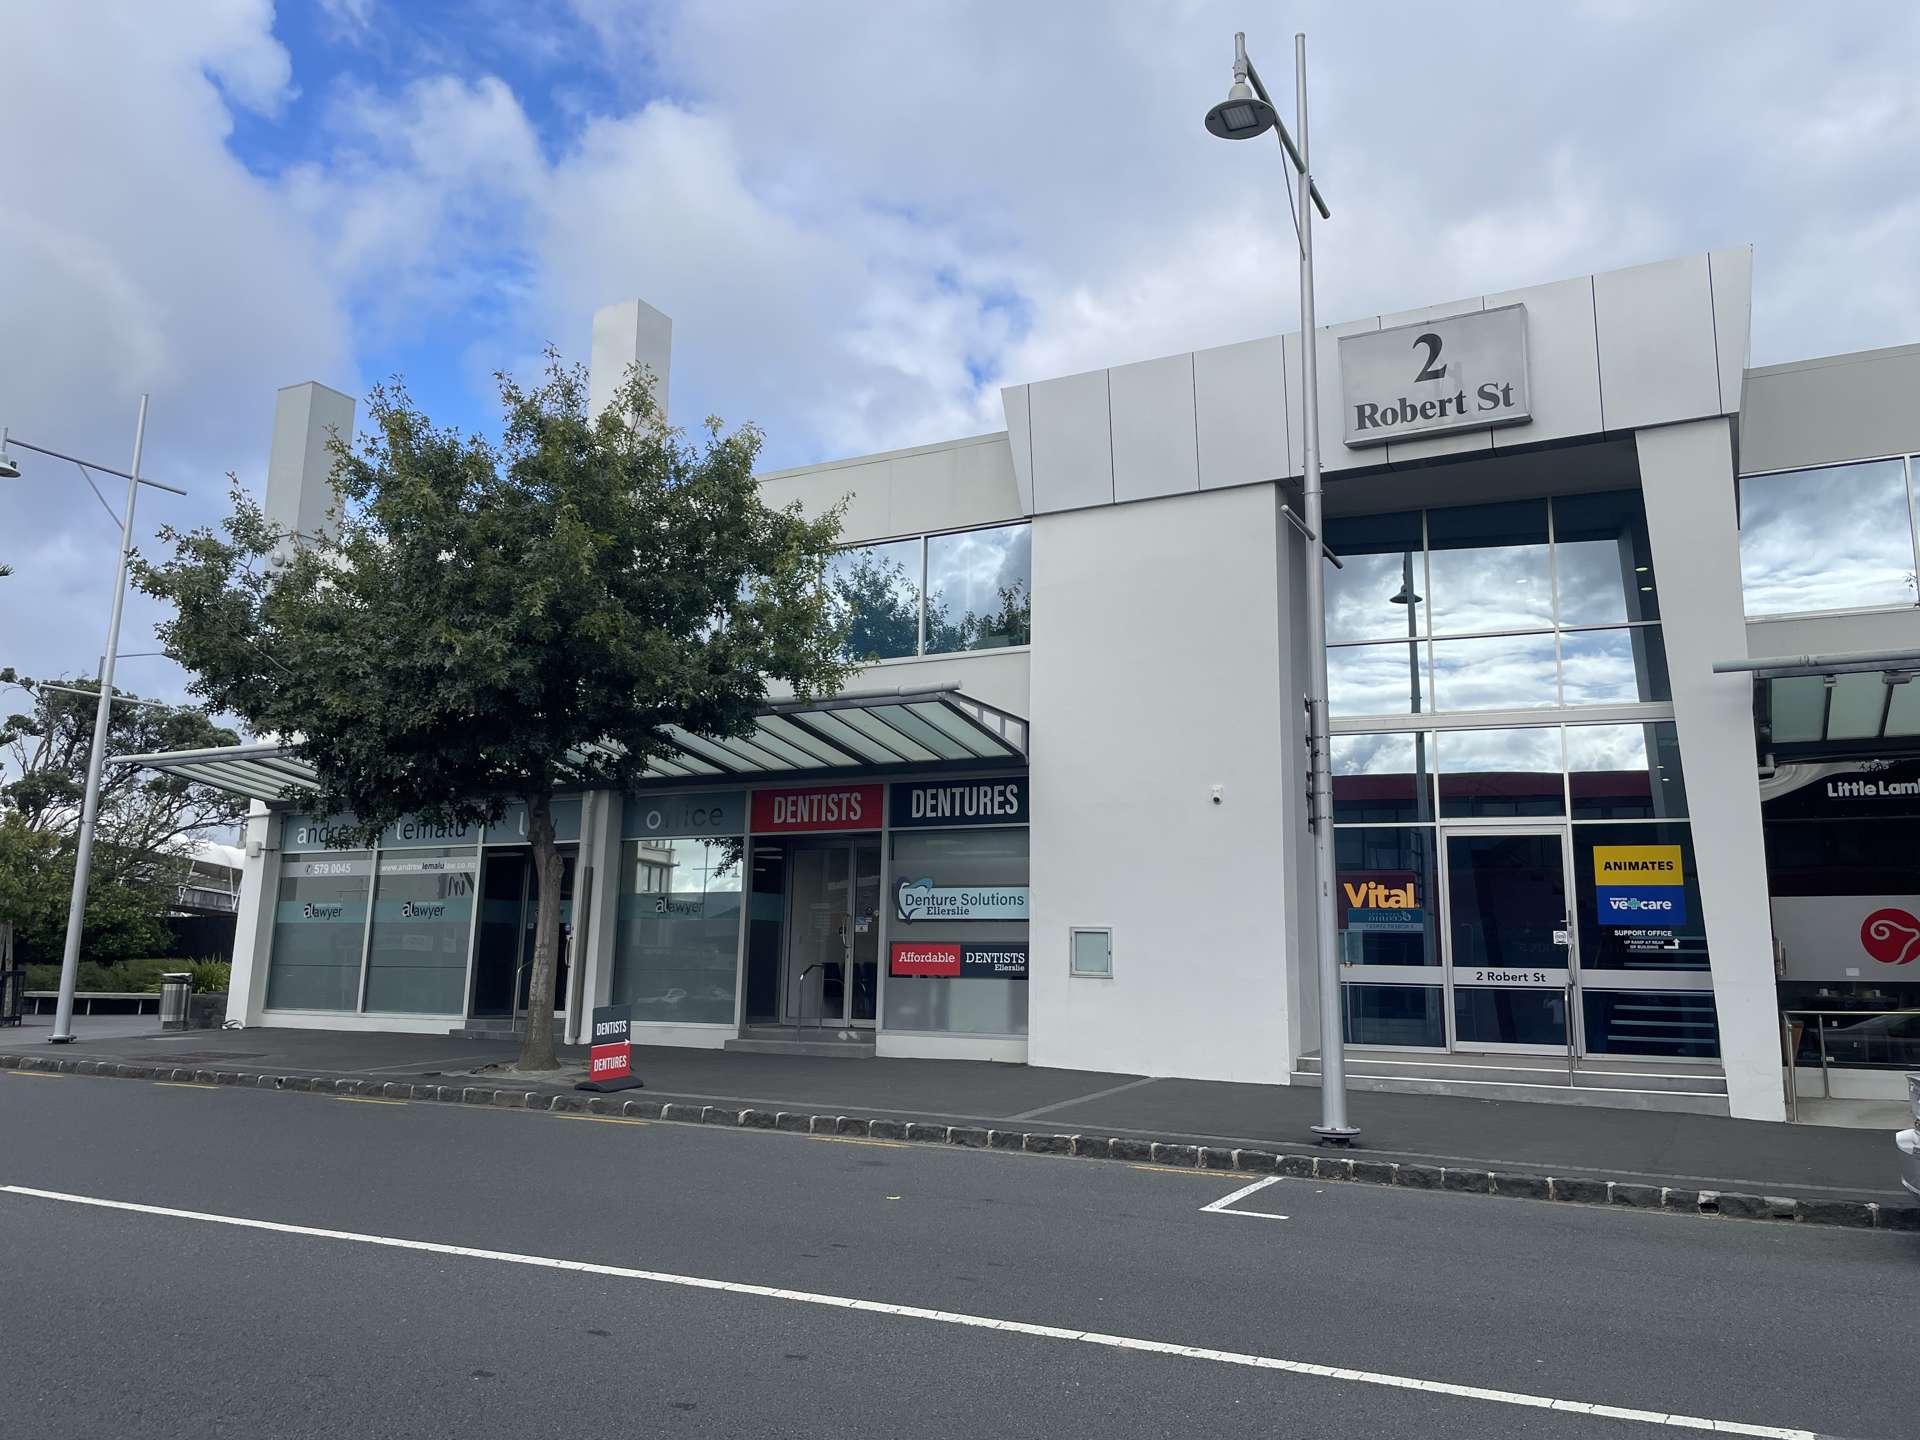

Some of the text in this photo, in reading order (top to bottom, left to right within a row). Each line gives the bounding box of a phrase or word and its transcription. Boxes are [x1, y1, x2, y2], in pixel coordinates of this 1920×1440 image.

[1412, 333, 1448, 383] 2
[1353, 382, 1515, 431] Robert St
[1827, 781, 1877, 797] Little
[773, 792, 862, 824] DENTISTS
[911, 784, 1019, 818] DENTURES
[313, 863, 351, 874] 579 0045
[1604, 861, 1674, 871] ANIMATES
[905, 892, 1025, 906] Denture Solutions
[1343, 881, 1415, 909] Vital
[926, 906, 970, 916] Ellerslie
[898, 951, 1025, 964] Affordable DENTISTS
[994, 964, 1025, 972] Ellerslie
[1476, 972, 1546, 983] 2 Robert St
[596, 1020, 627, 1036] DENTISTS
[593, 1055, 627, 1072] DENTURES
